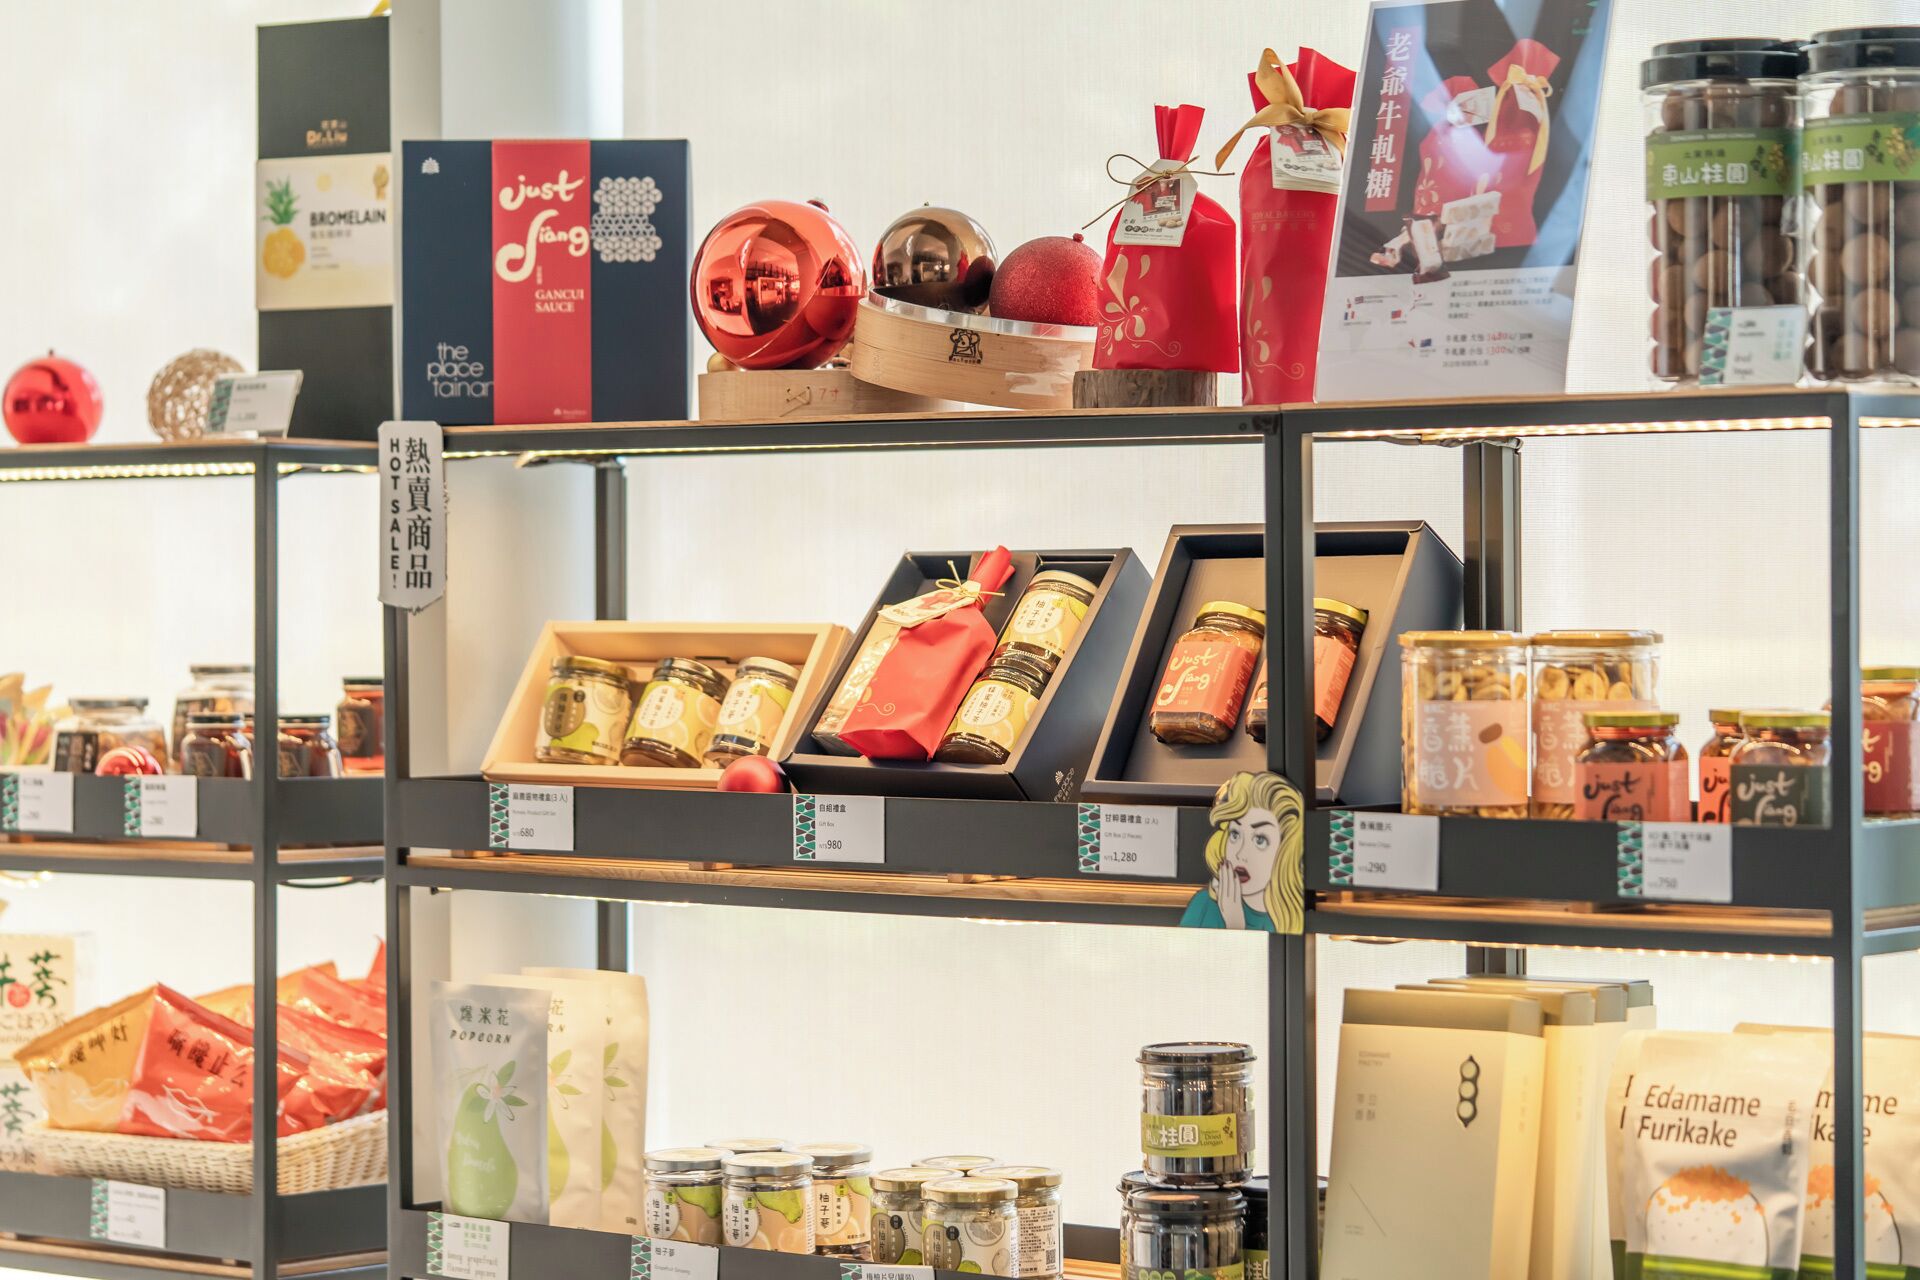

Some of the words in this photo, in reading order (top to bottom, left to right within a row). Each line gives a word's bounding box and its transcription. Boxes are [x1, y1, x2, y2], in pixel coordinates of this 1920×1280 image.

[1365, 32, 1412, 199] 老爺牛軋糖
[499, 169, 586, 211] just
[310, 208, 387, 227] BROMELAIN
[535, 289, 584, 300] GANCUI
[535, 302, 575, 313] SAUCE
[437, 342, 469, 360] the
[427, 358, 485, 381] place
[390, 438, 400, 490] HOT
[405, 437, 432, 589] 熱賣商品
[390, 499, 400, 588] SALE!
[1169, 647, 1219, 671] just
[1584, 771, 1640, 800] just
[1703, 768, 1728, 793] ju
[1737, 771, 1794, 801] just
[819, 803, 847, 813] 自組禮盒
[819, 840, 842, 849] NT$980
[1104, 852, 1137, 862] NT$1,280
[460, 1005, 510, 1026] 爆米花
[450, 1029, 512, 1044] POPCORN
[1644, 1084, 1761, 1117] Edamame
[1637, 1115, 1738, 1148] Furikake
